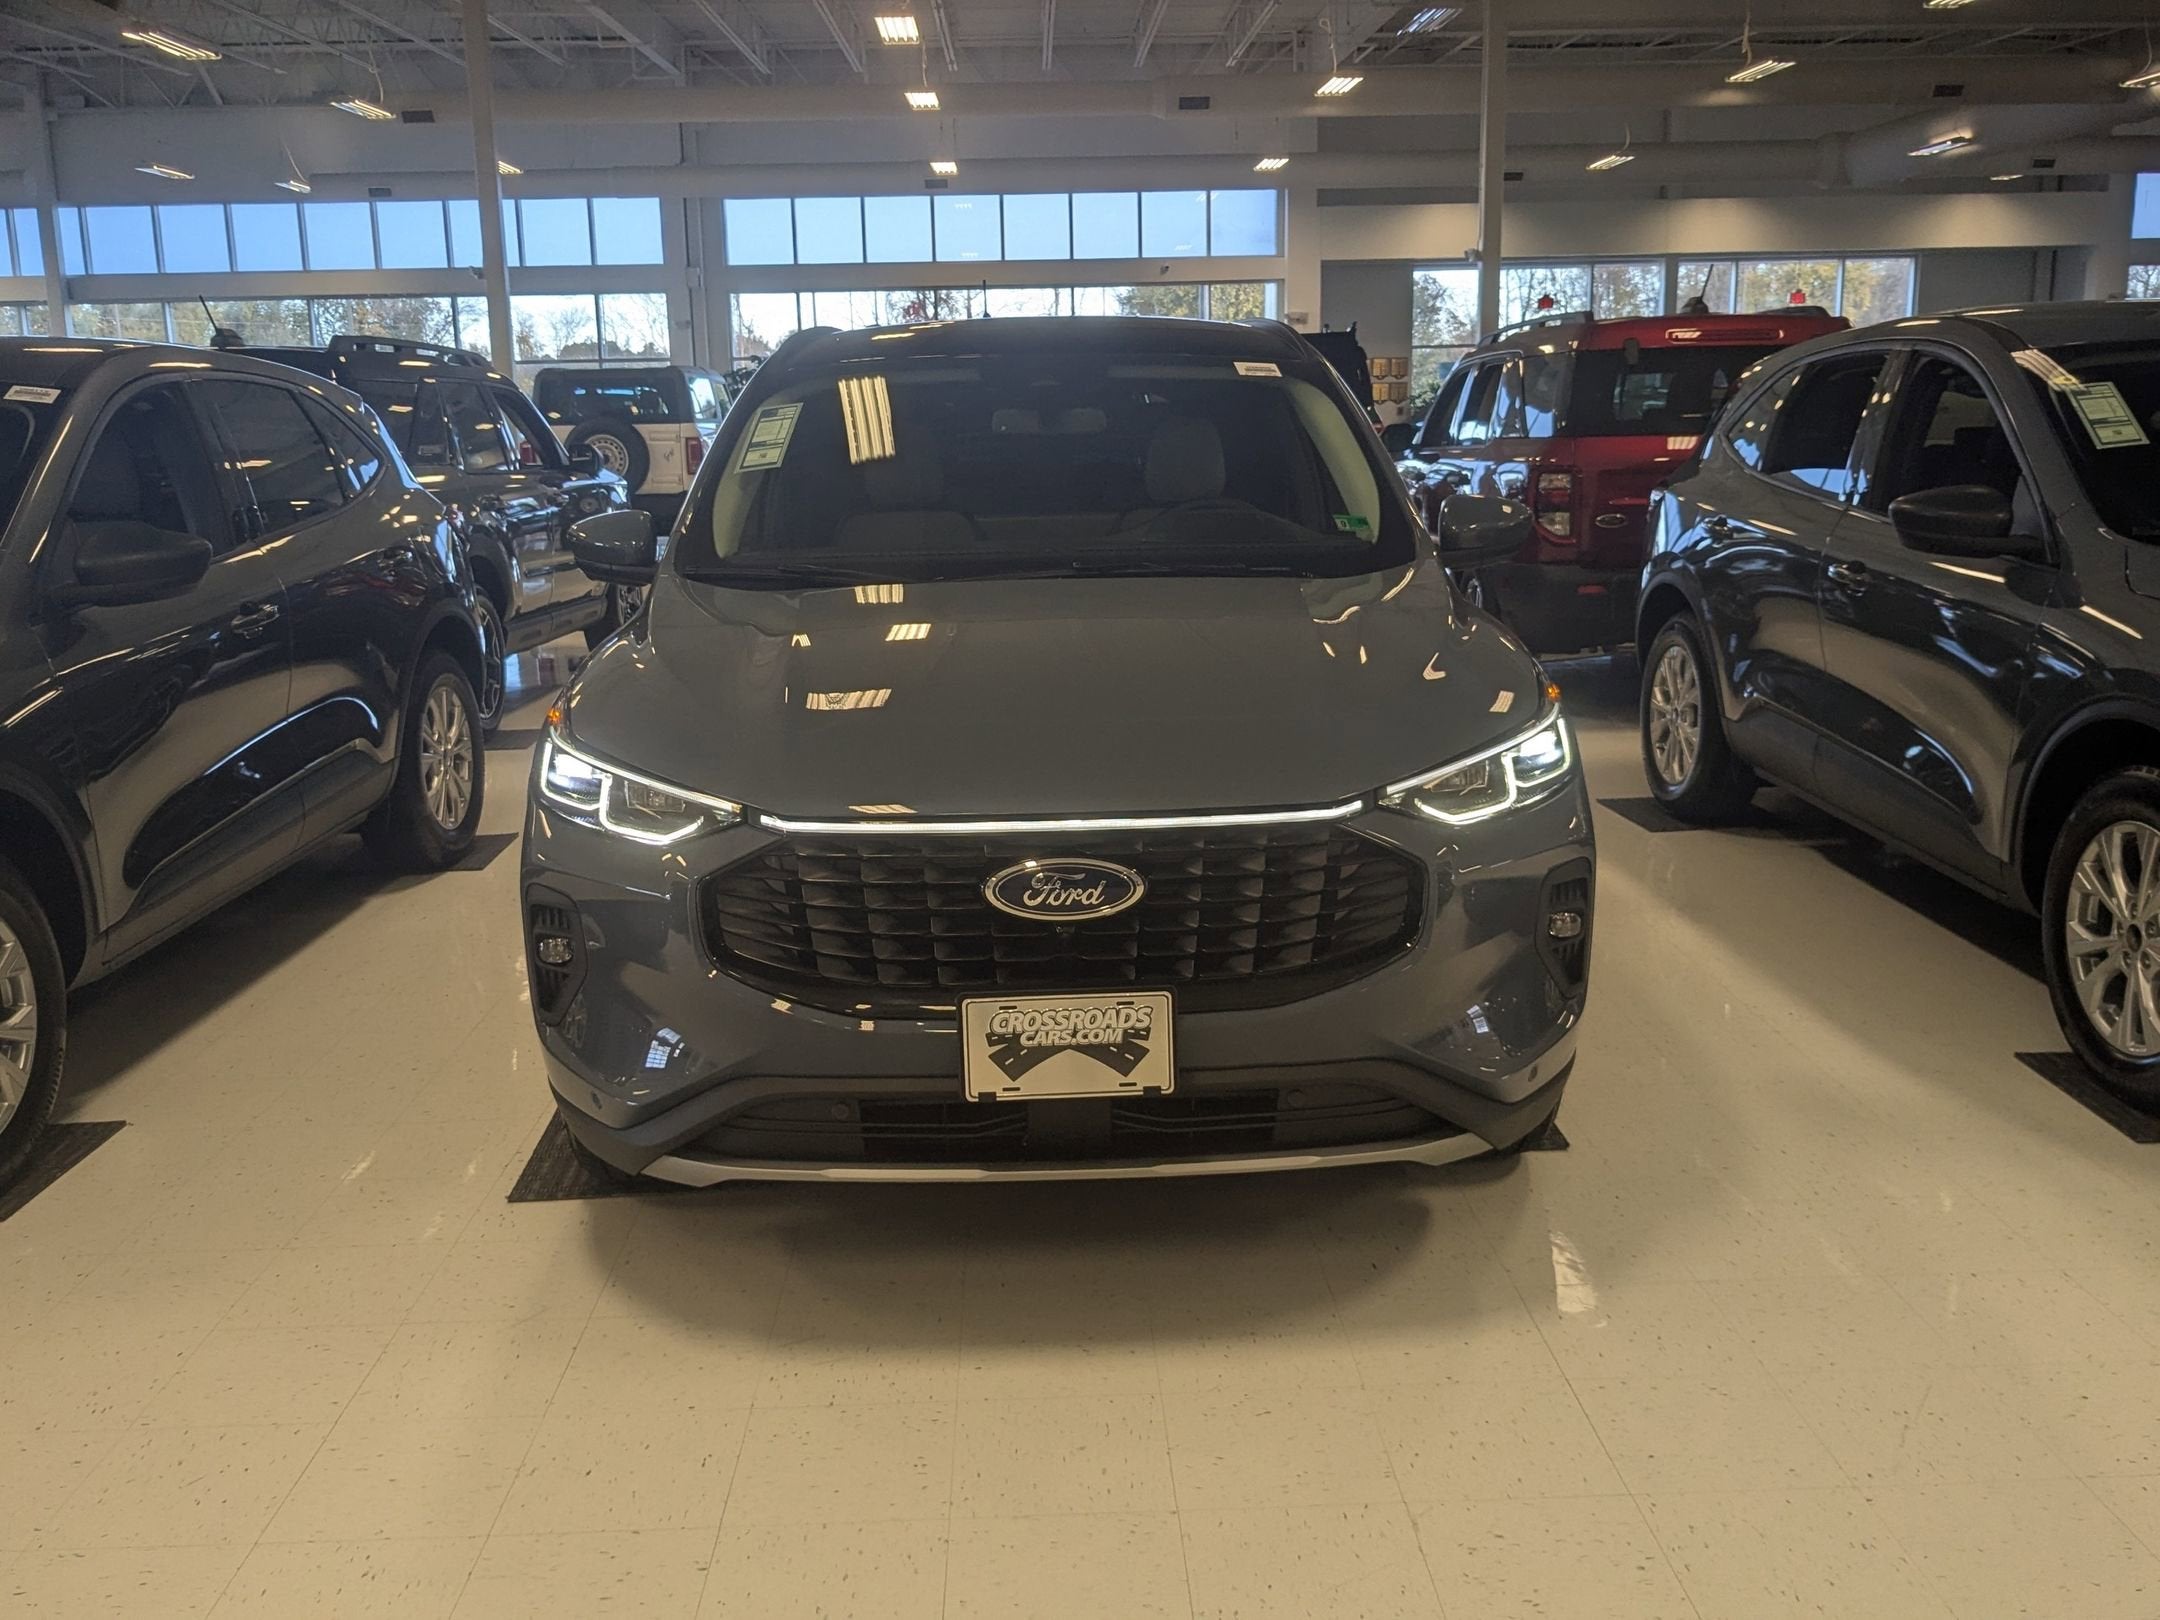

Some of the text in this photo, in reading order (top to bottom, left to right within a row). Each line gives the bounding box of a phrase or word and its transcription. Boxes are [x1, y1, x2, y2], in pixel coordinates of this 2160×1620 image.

[1023, 871, 1106, 906] Ford
[990, 1006, 1153, 1034] CROSSROADS
[1019, 1028, 1123, 1047] CARS.COM
